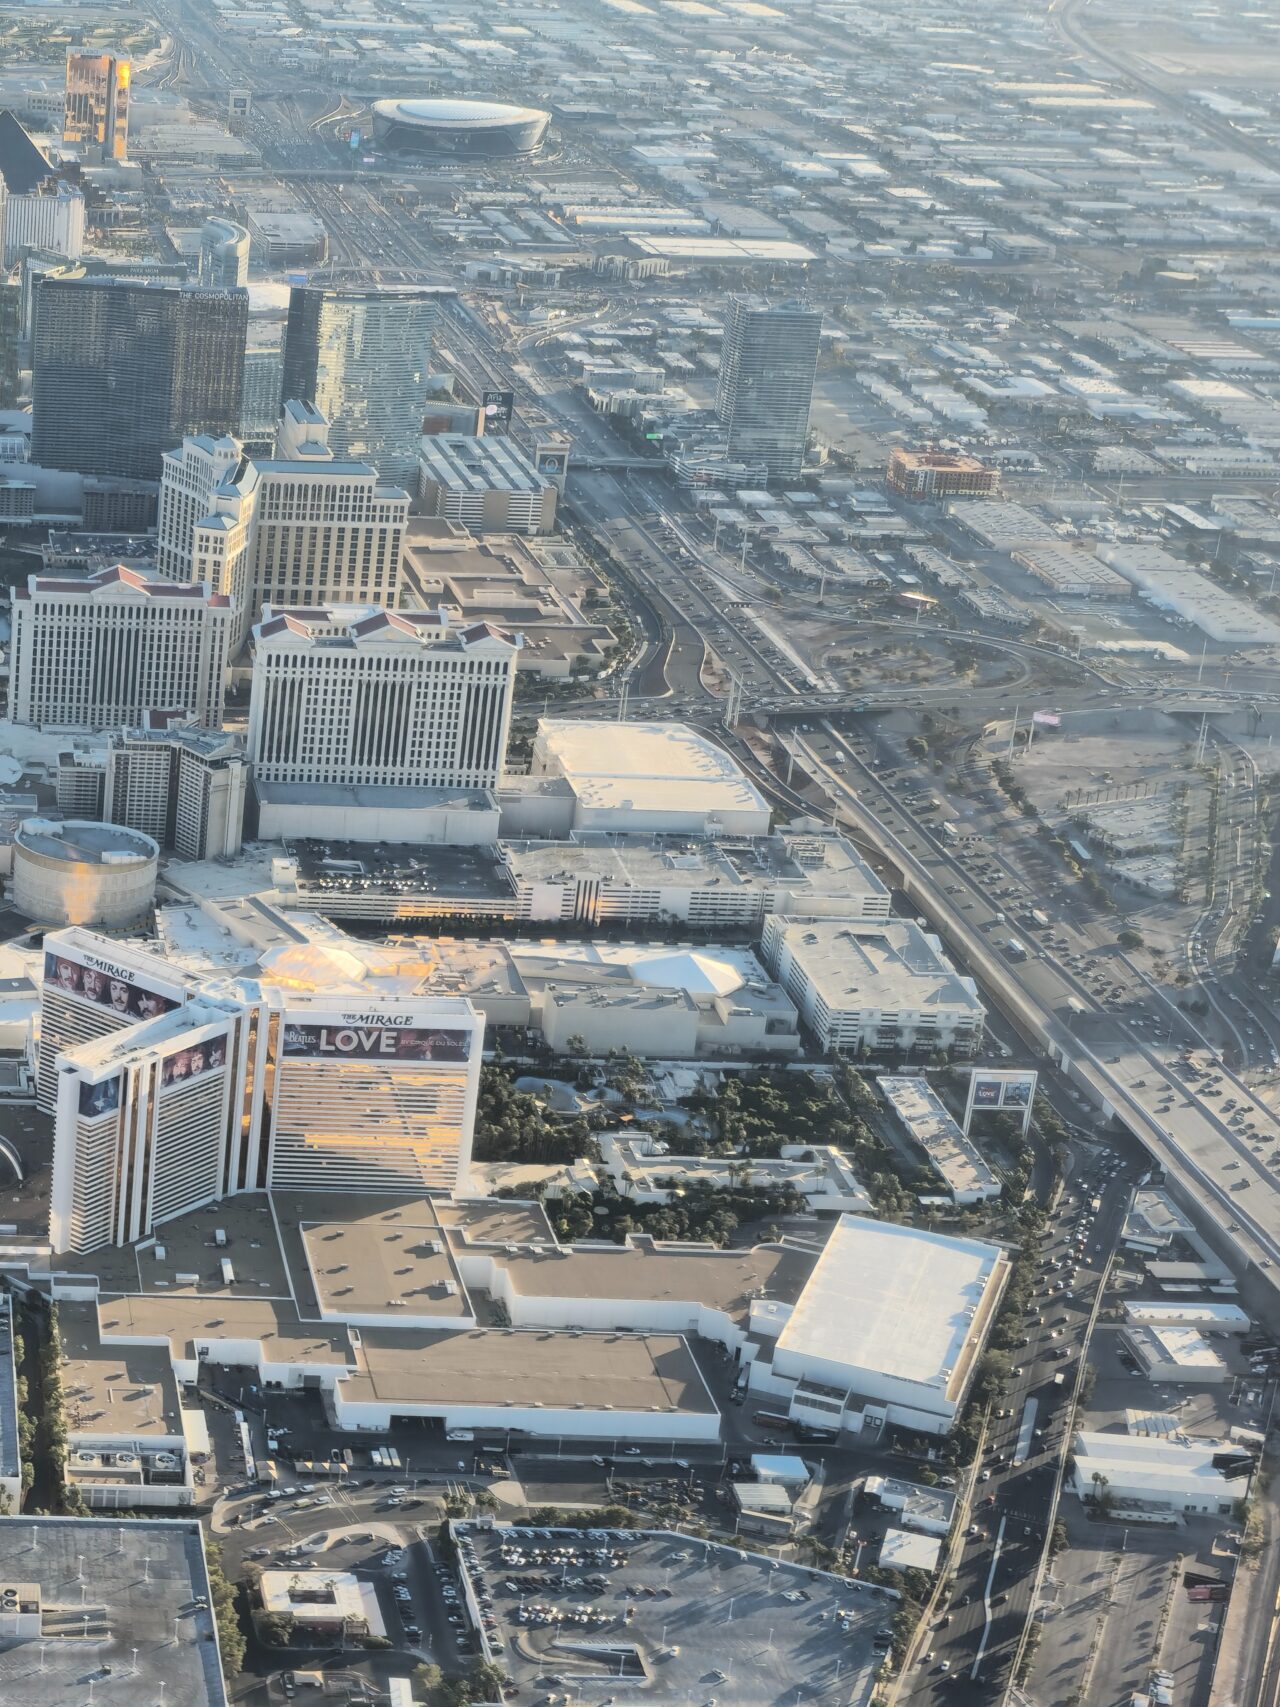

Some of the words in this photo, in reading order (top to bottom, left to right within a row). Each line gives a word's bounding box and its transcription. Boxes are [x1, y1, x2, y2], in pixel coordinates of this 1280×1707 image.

[195, 292, 249, 301] COSMOPOLITAN
[84, 954, 94, 962] THE
[93, 958, 135, 982] MIRAGE
[356, 1014, 413, 1026] MIRAGE
[321, 1029, 397, 1053] LOVE
